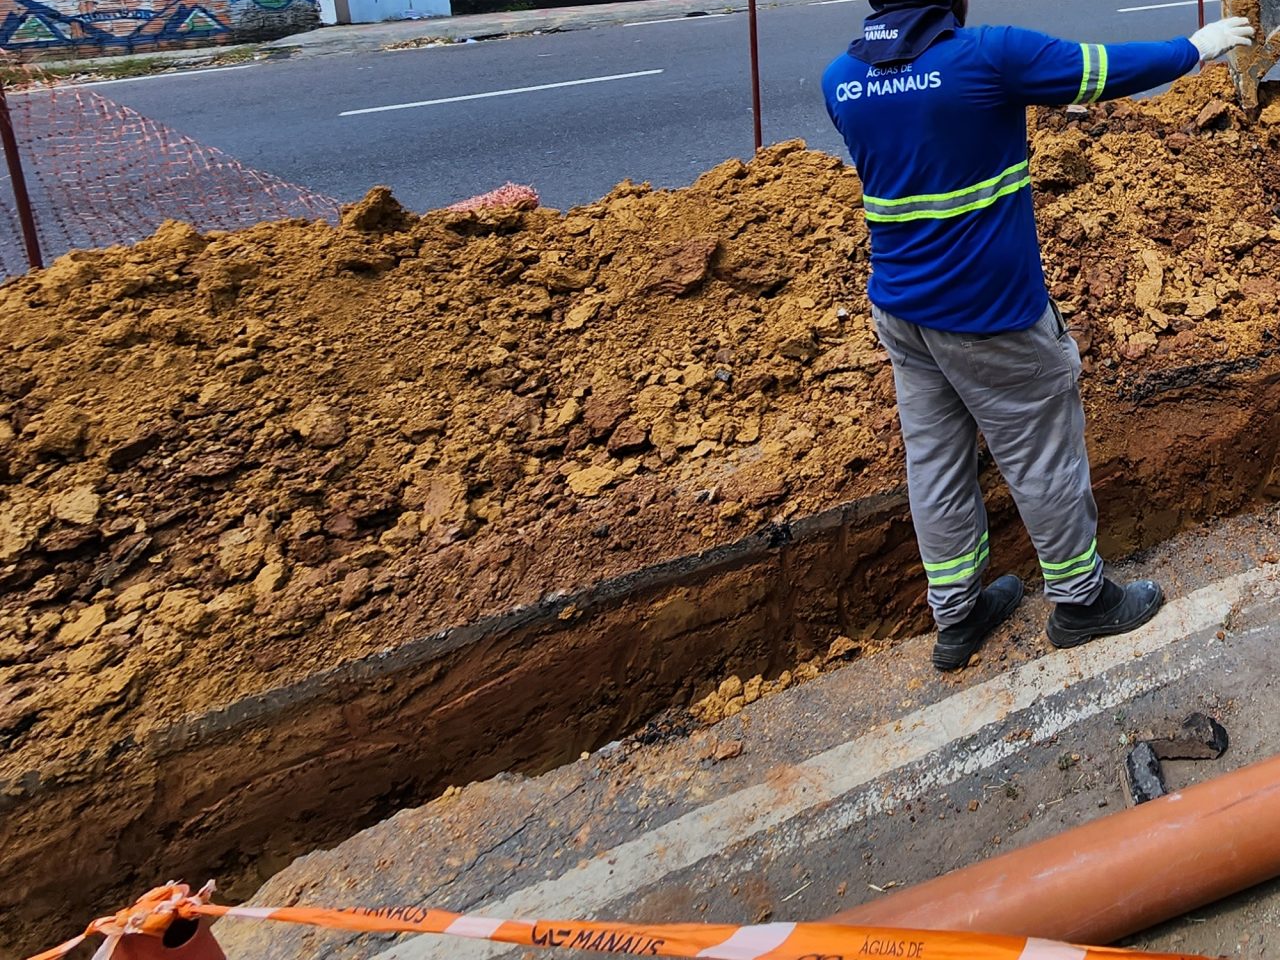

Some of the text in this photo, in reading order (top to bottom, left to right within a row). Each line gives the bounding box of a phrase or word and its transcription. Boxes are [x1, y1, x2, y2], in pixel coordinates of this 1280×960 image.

[866, 63, 913, 78] ÁGUAS DE
[867, 71, 942, 97] MANAUS
[858, 935, 925, 959] ÁGUAS DE
